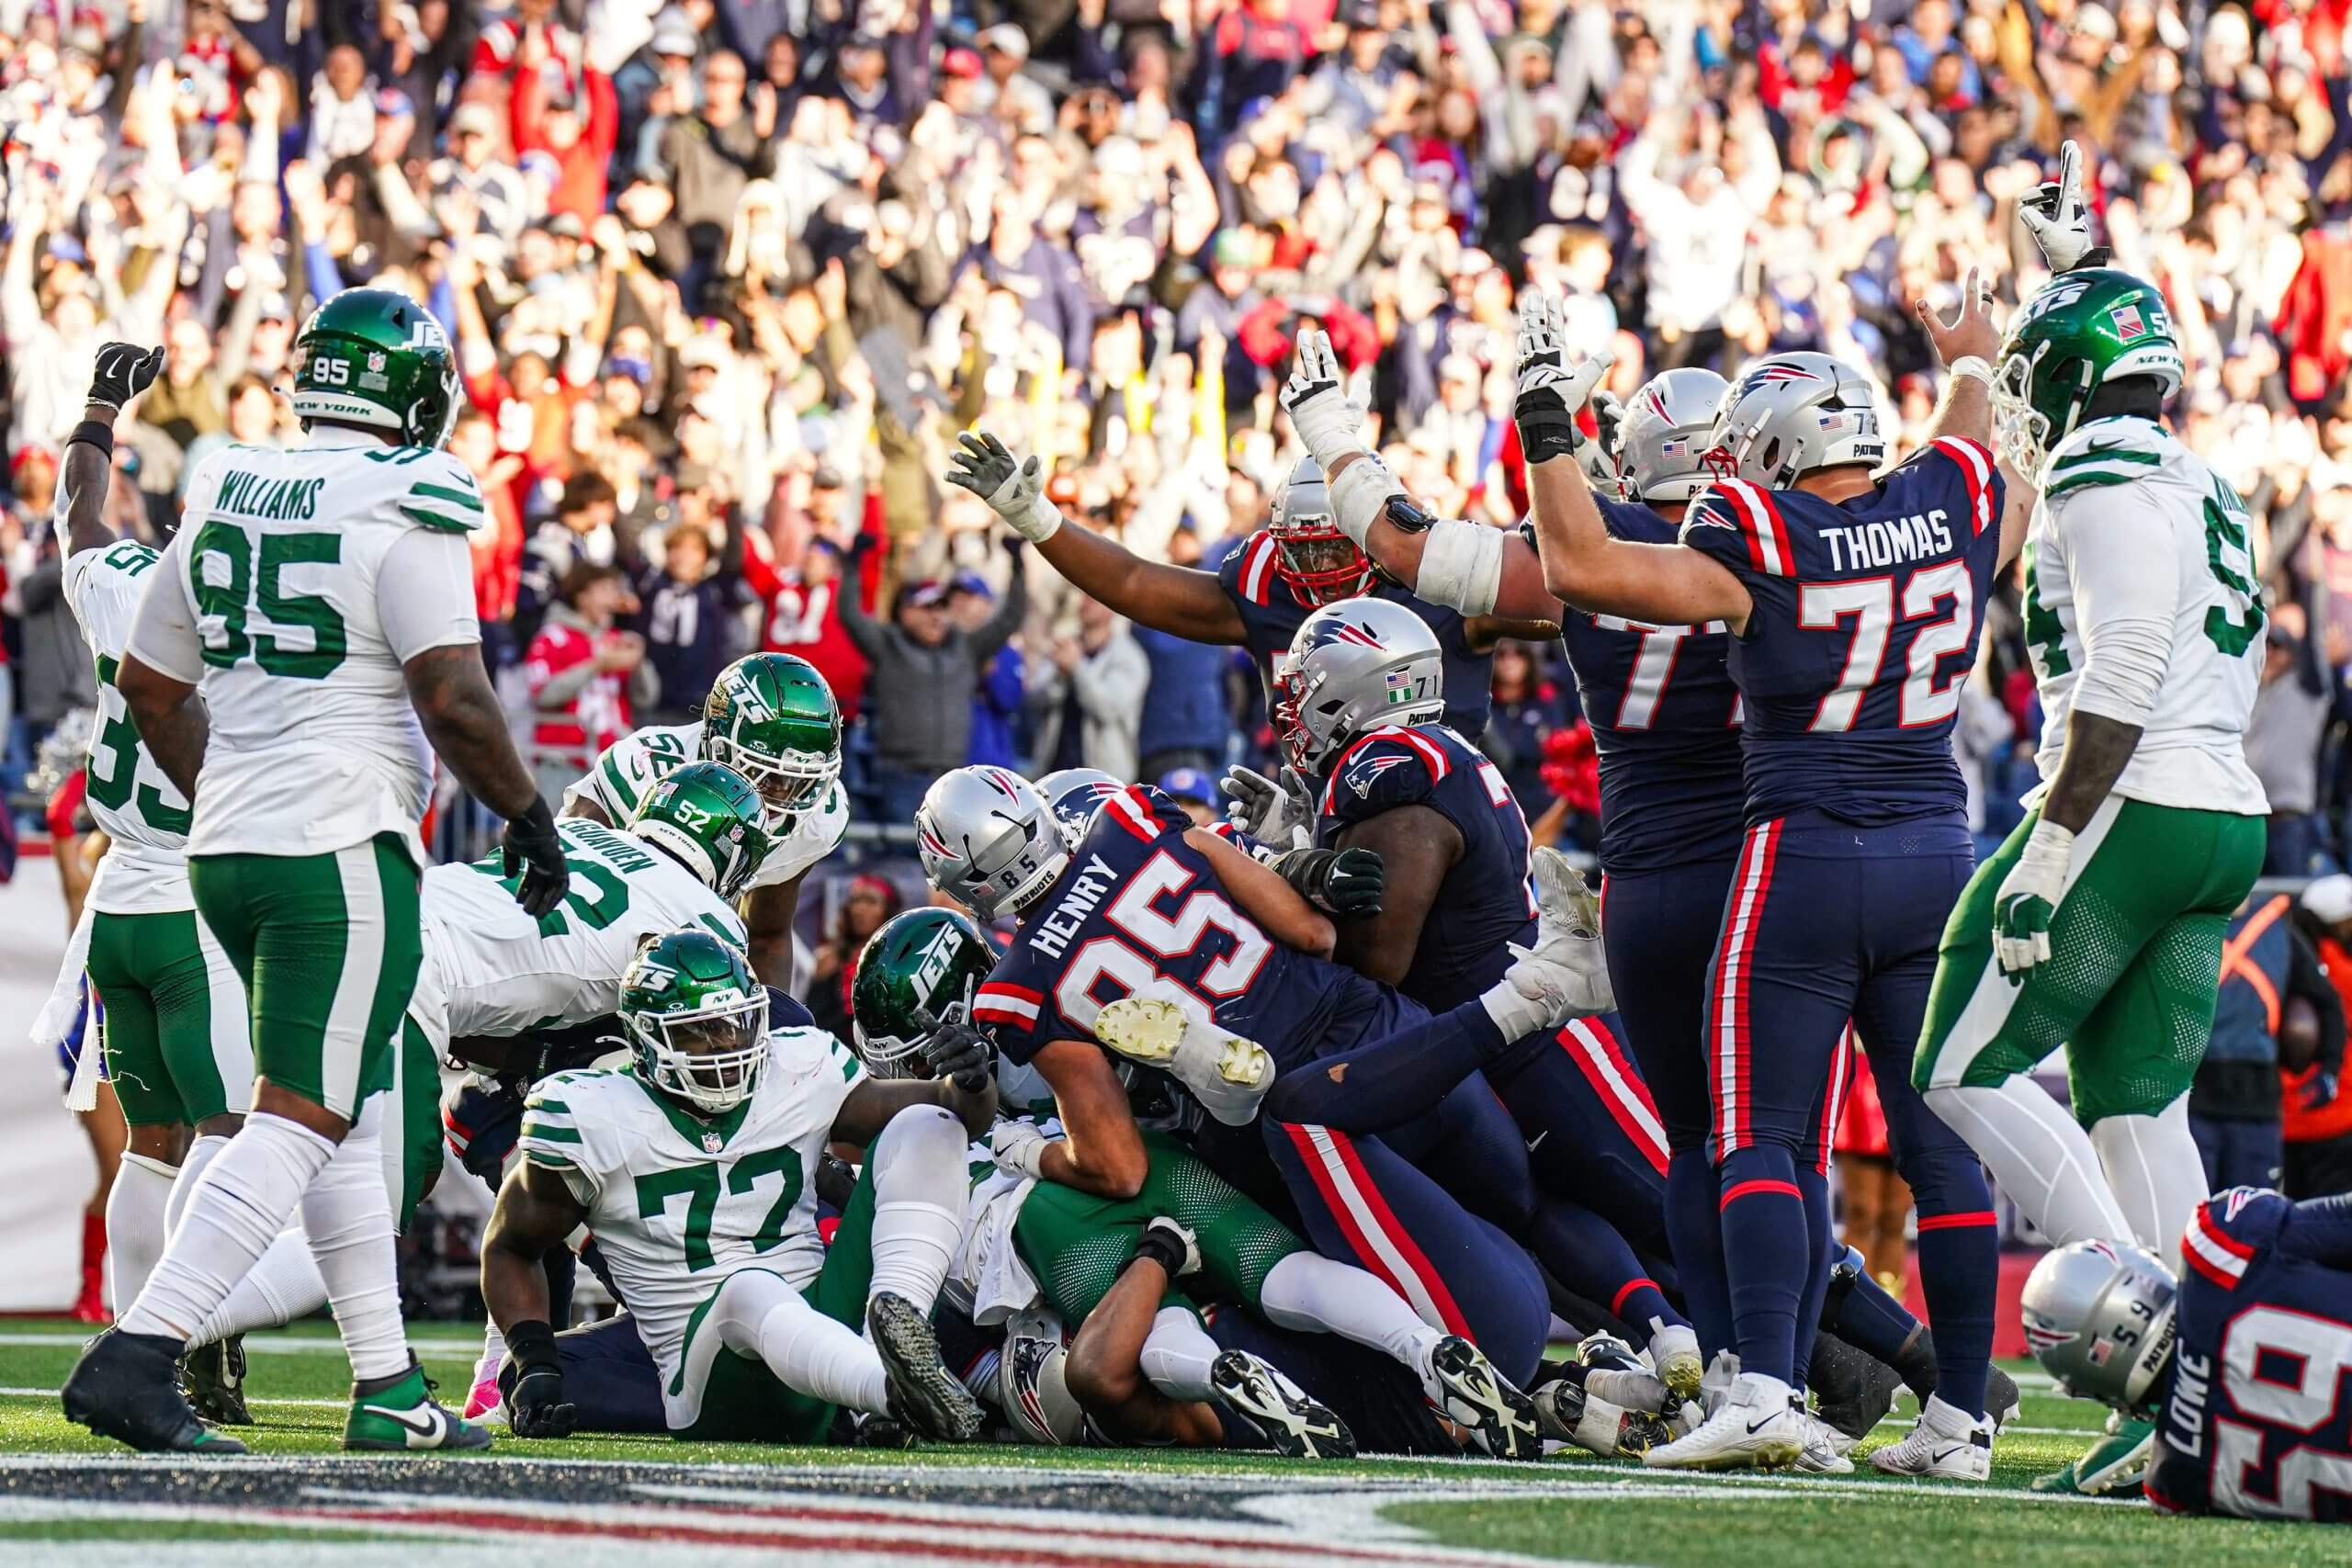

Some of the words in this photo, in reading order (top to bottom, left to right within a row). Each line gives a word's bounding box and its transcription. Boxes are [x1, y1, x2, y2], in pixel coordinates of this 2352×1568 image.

[401, 321, 442, 348] JE
[2149, 312, 2175, 337] 5
[313, 356, 350, 385] 95
[323, 401, 372, 415] YORK
[214, 469, 325, 520] WILLIAMS
[1818, 510, 1953, 571] THOMAS
[189, 520, 347, 680] 95
[1593, 614, 1745, 731] 7
[1797, 558, 1974, 733] 72
[722, 669, 781, 725] ETS
[1415, 674, 1437, 699] 71
[673, 799, 712, 835] 52
[1012, 870, 1056, 909] PATRIOTS
[1028, 852, 1118, 960] HENRY
[910, 920, 964, 1012] JETS
[1052, 847, 1275, 1038] 85
[712, 992, 734, 1004] NY
[634, 1146, 804, 1274] 72
[2165, 1337, 2211, 1459] LOWE
[2209, 1302, 2352, 1520] 59
